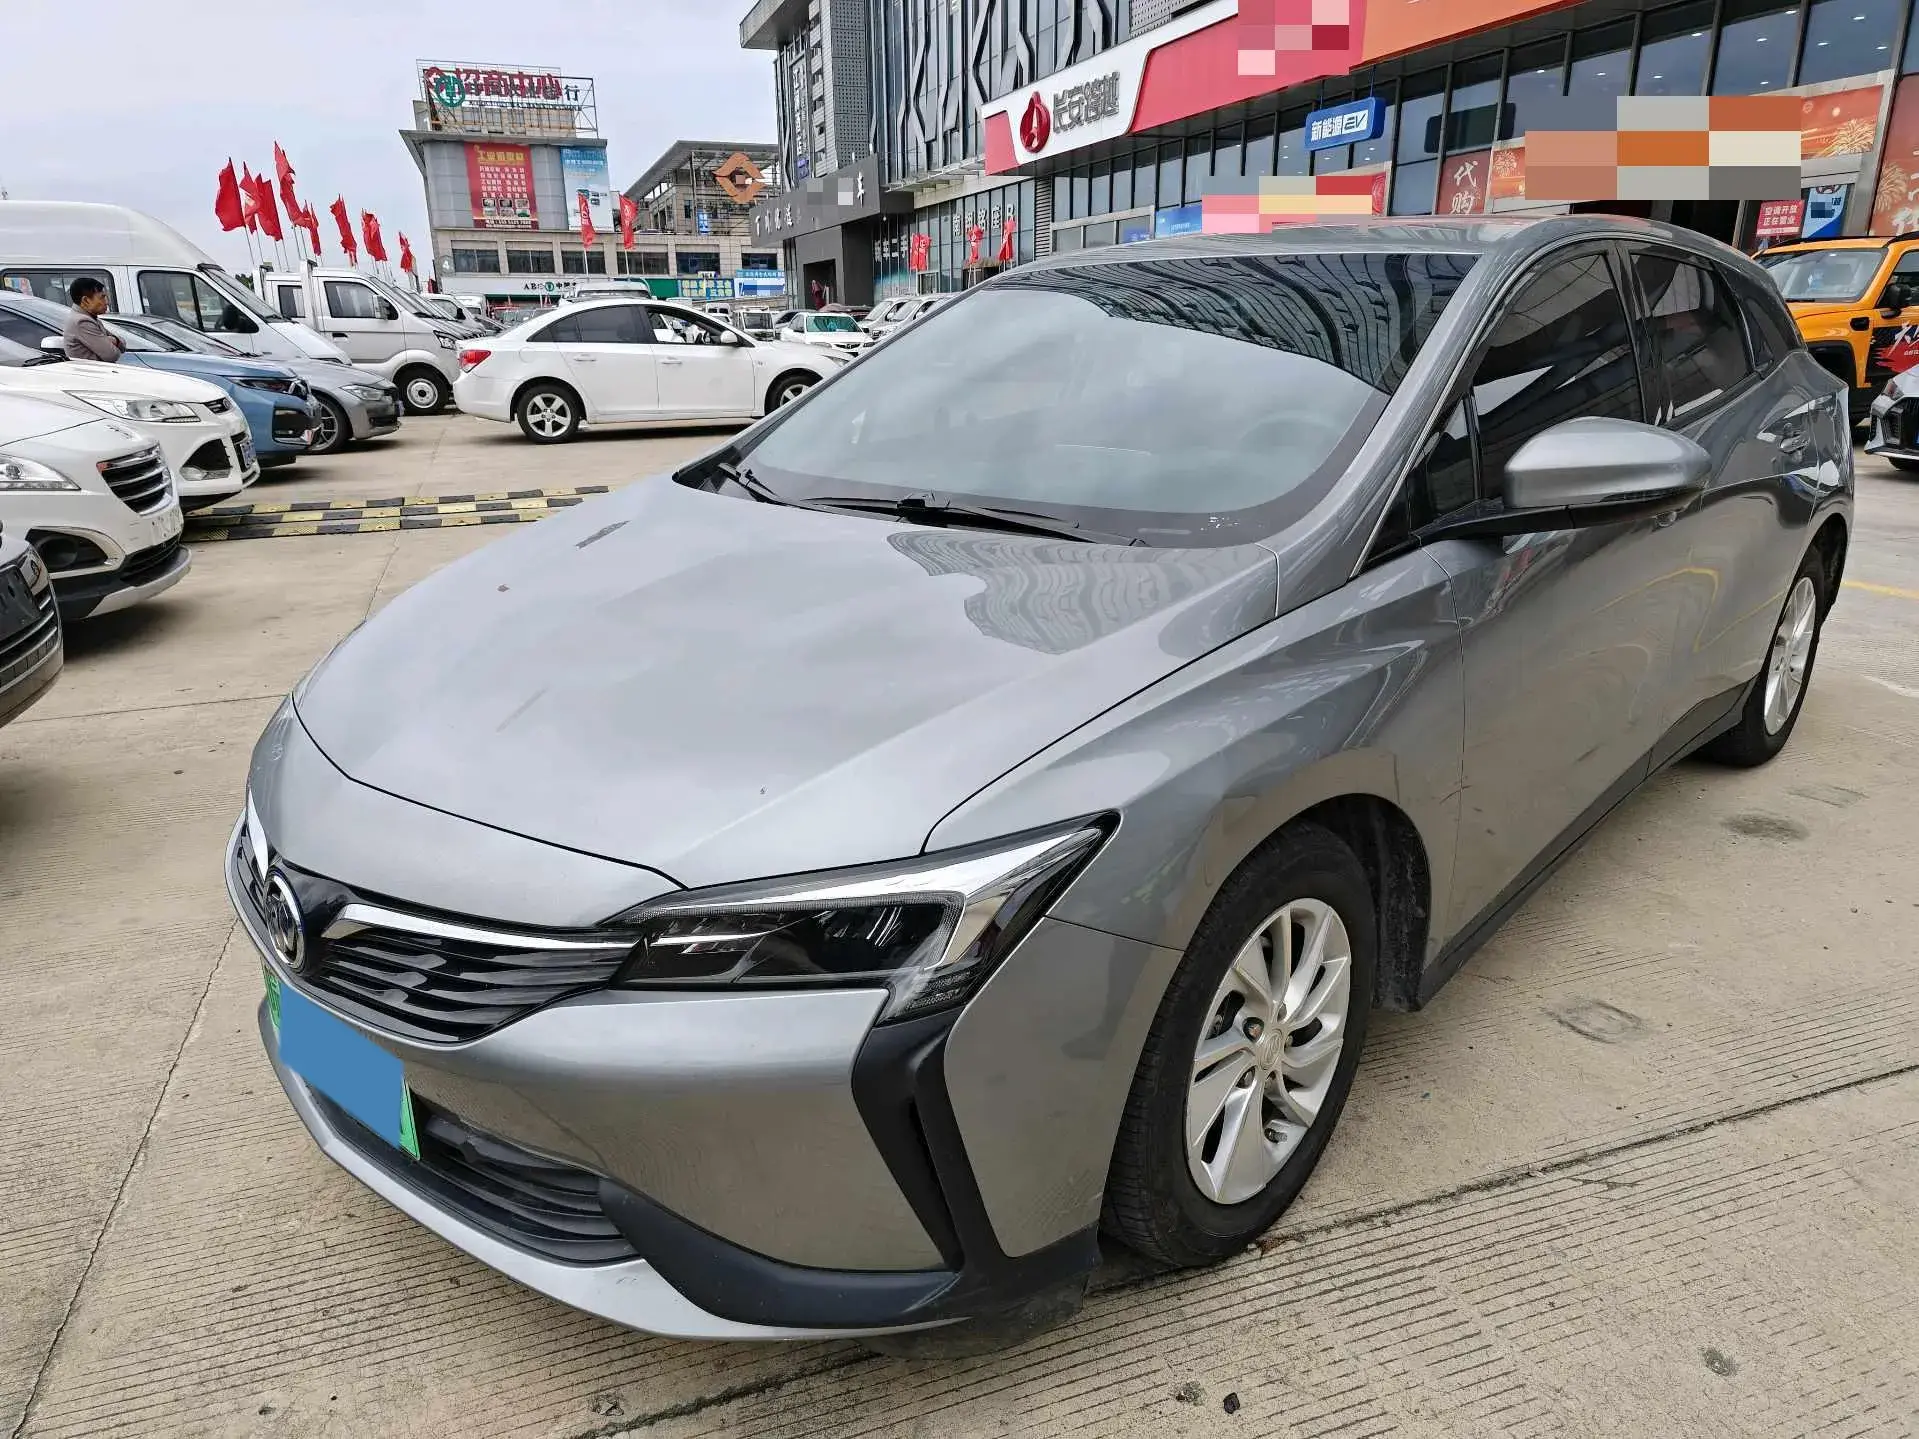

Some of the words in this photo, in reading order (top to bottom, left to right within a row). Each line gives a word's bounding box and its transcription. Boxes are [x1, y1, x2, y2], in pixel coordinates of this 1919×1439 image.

[1311, 115, 1343, 142] 新能源
[1345, 113, 1366, 130] EV
[1763, 215, 1796, 226] 正在营业
